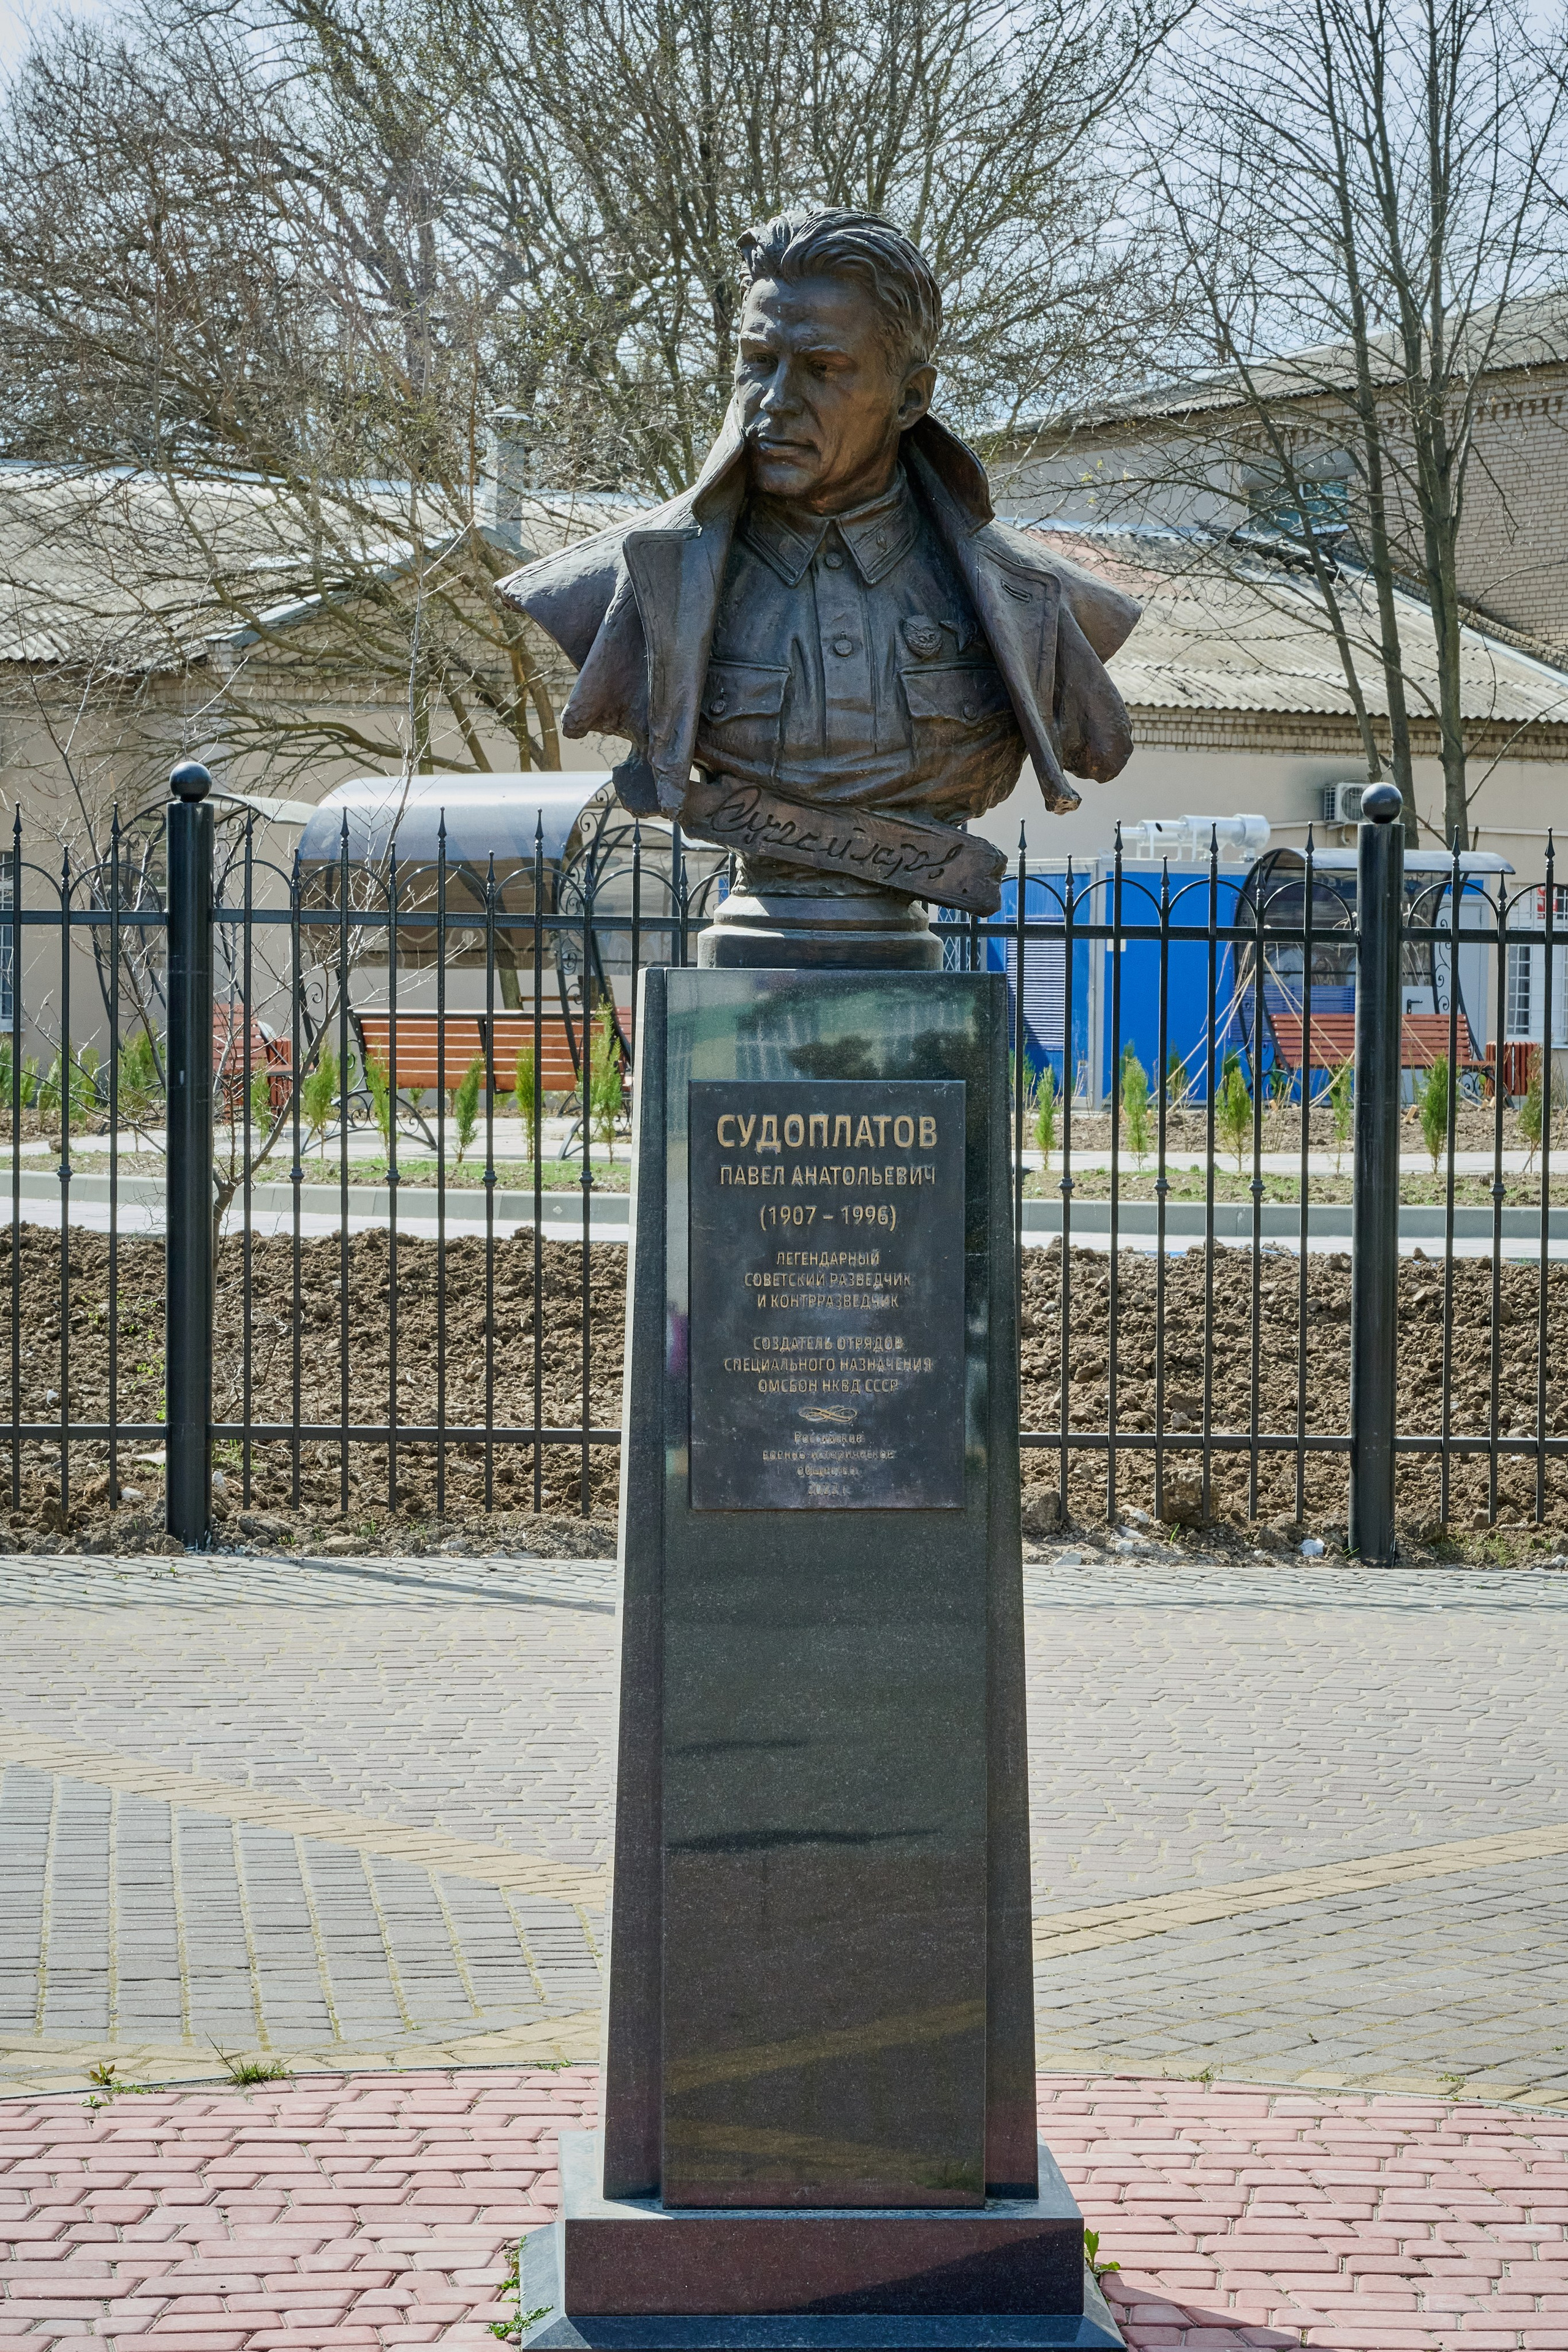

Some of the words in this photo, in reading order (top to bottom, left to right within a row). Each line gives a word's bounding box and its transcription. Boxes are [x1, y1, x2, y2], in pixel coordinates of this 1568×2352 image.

[717, 1114, 938, 1153] СУДОПЛАТОВ
[720, 1166, 785, 1186] ПАВЕЛ
[791, 1166, 936, 1186] АНАТОЛЬЕВИЧ
[760, 1205, 817, 1231] (1907
[841, 1205, 897, 1231] 1996)
[776, 1250, 880, 1267] ЛЕГЕНДАРНЫЙ
[831, 1272, 911, 1289] РАЗВЕДЧИК
[758, 1295, 766, 1308] И
[771, 1294, 899, 1310] КОНТРРАЗВЕДЧИК
[753, 1336, 832, 1352] СОЗДАТЕЛЬ
[837, 1336, 903, 1352] ОТРЯДОВ
[724, 1358, 835, 1373] СПЕЦИАЛЬНОГО
[840, 1358, 932, 1372] НАЗНАЧЕНИЯ
[758, 1379, 818, 1393] ОМСБОН
[823, 1379, 861, 1395] НКВД
[865, 1379, 899, 1393] СССР
